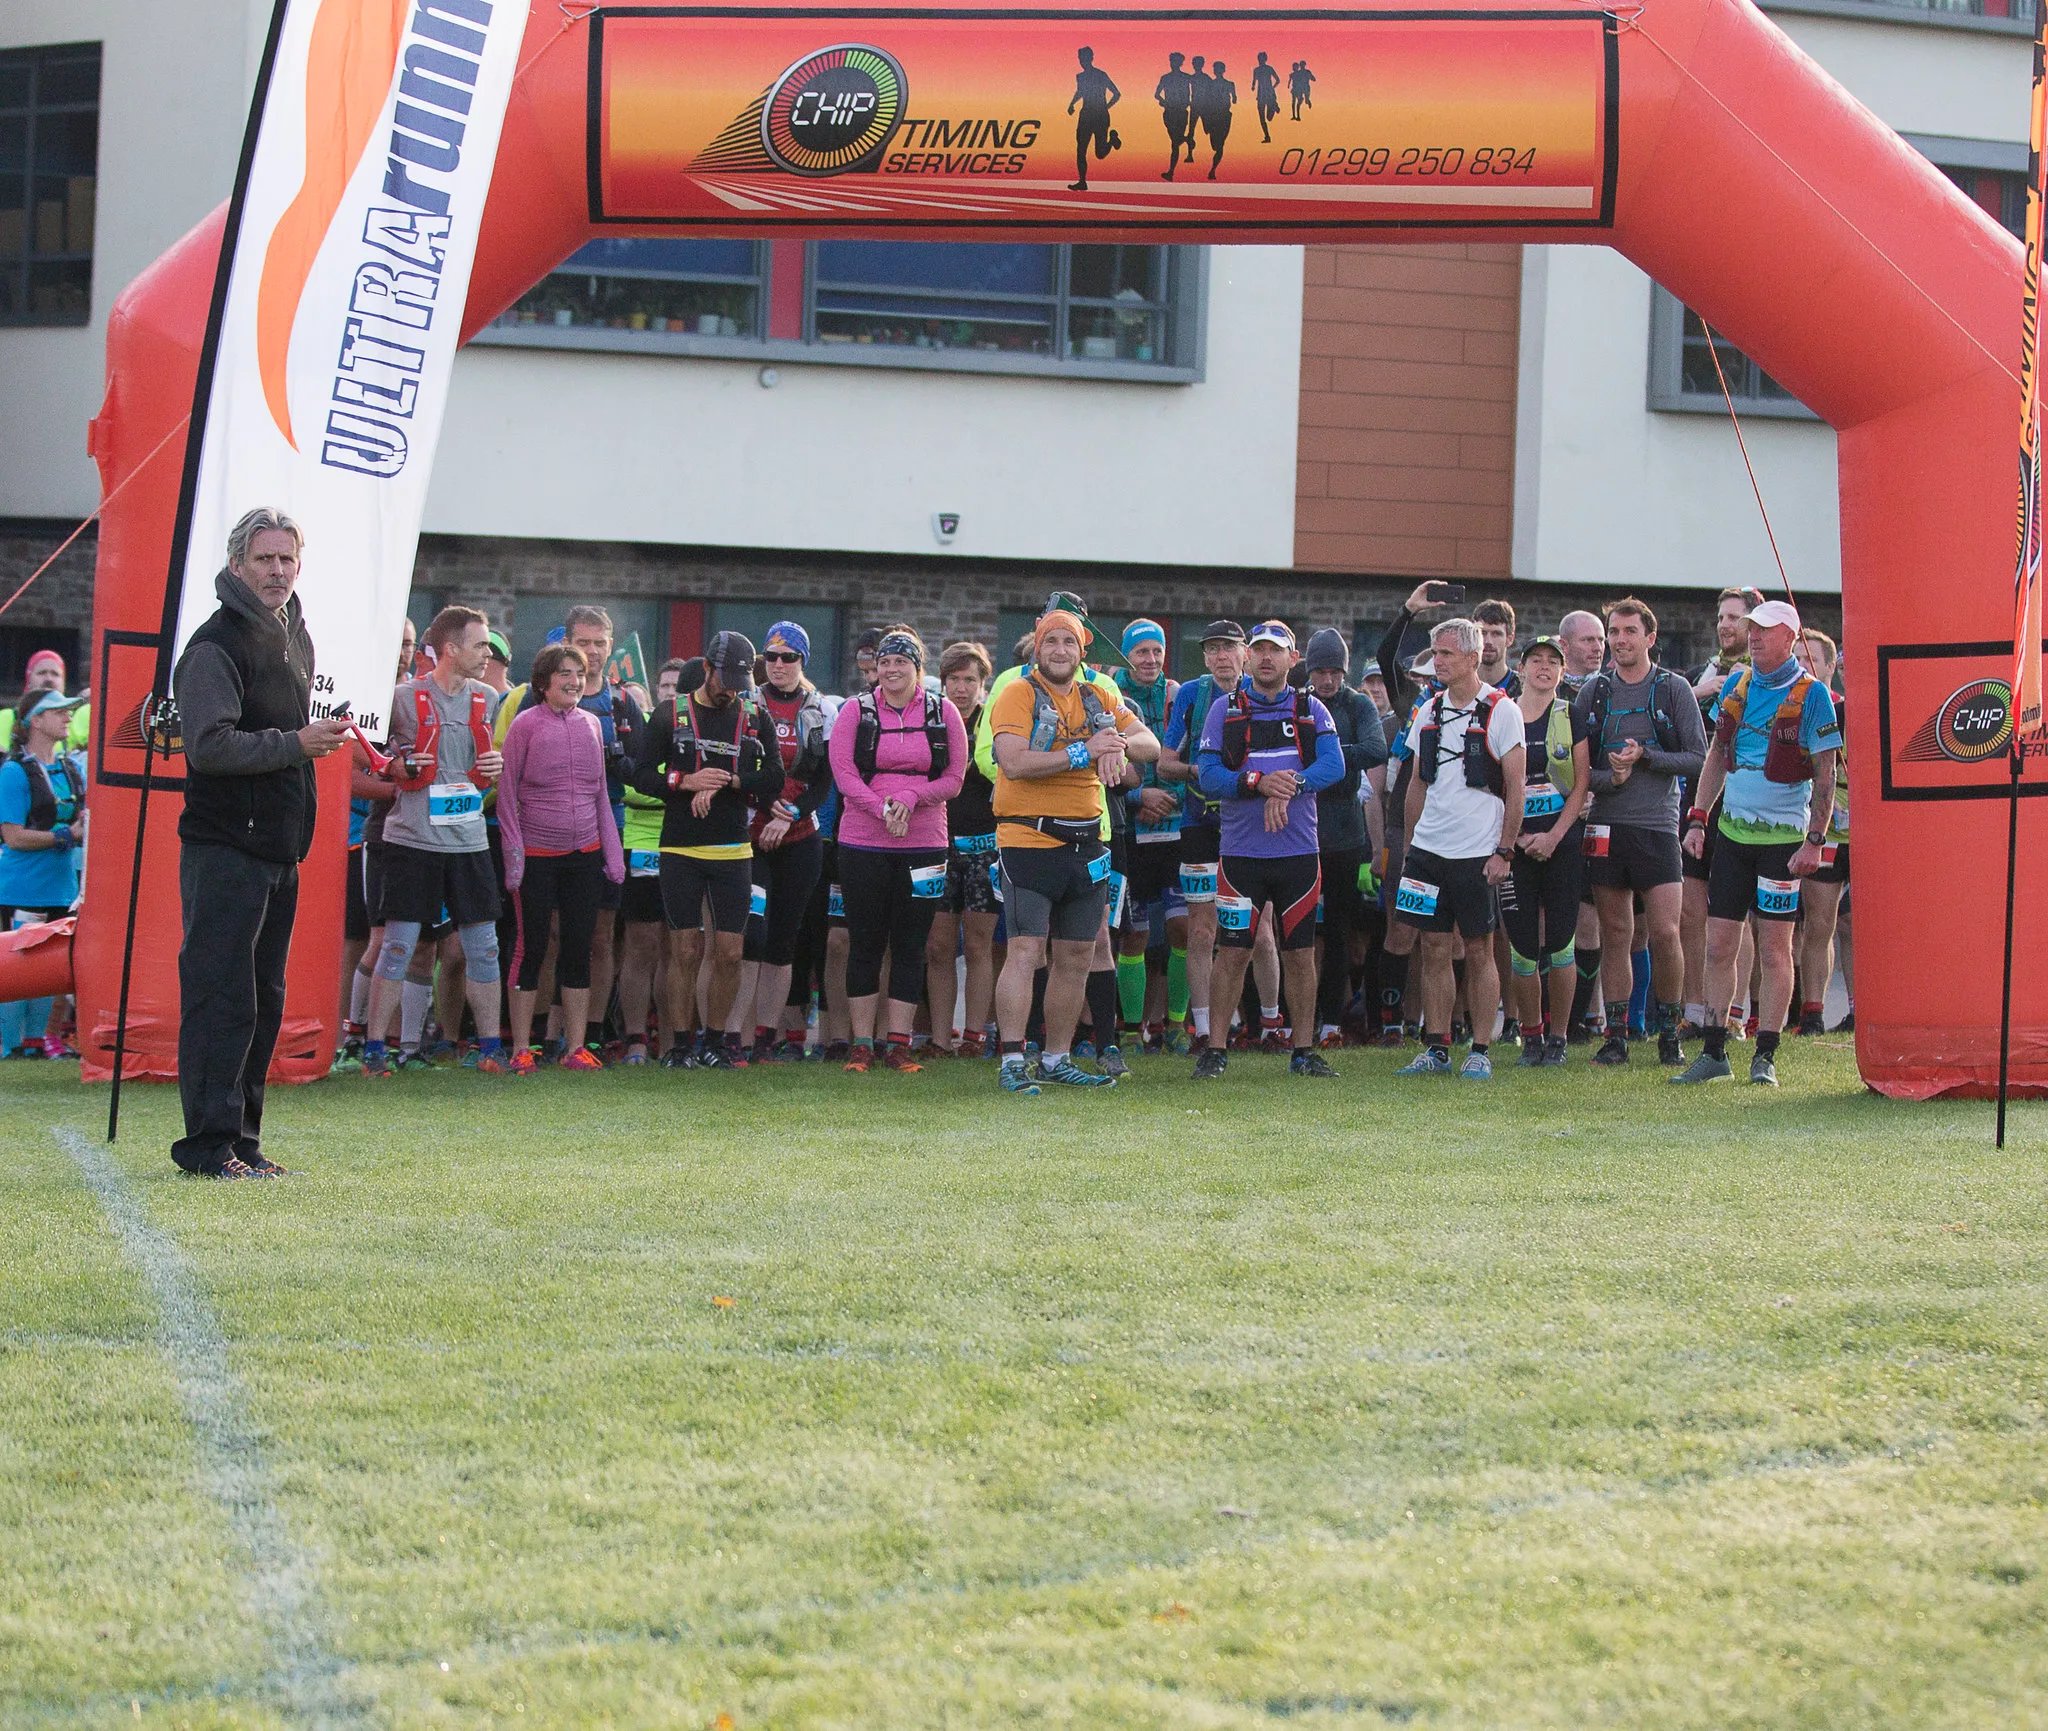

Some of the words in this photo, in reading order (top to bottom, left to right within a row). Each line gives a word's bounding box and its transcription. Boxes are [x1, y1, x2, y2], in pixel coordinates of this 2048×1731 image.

[791, 91, 875, 126] CHIP
[903, 118, 1041, 149] TIMING
[884, 152, 1027, 175] SERVICES
[1279, 147, 1390, 176] 01299
[1395, 147, 1465, 176] 250
[1469, 147, 1538, 176] 834
[321, 0, 494, 479] ULTRArunn
[312, 674, 335, 695] 34
[1953, 708, 2004, 731] CHIP
[444, 797, 472, 814] 230
[1526, 797, 1548, 814] 221
[969, 835, 995, 852] 305
[1185, 877, 1211, 893] 178
[1398, 891, 1424, 911] 202
[1763, 894, 1792, 910] 284
